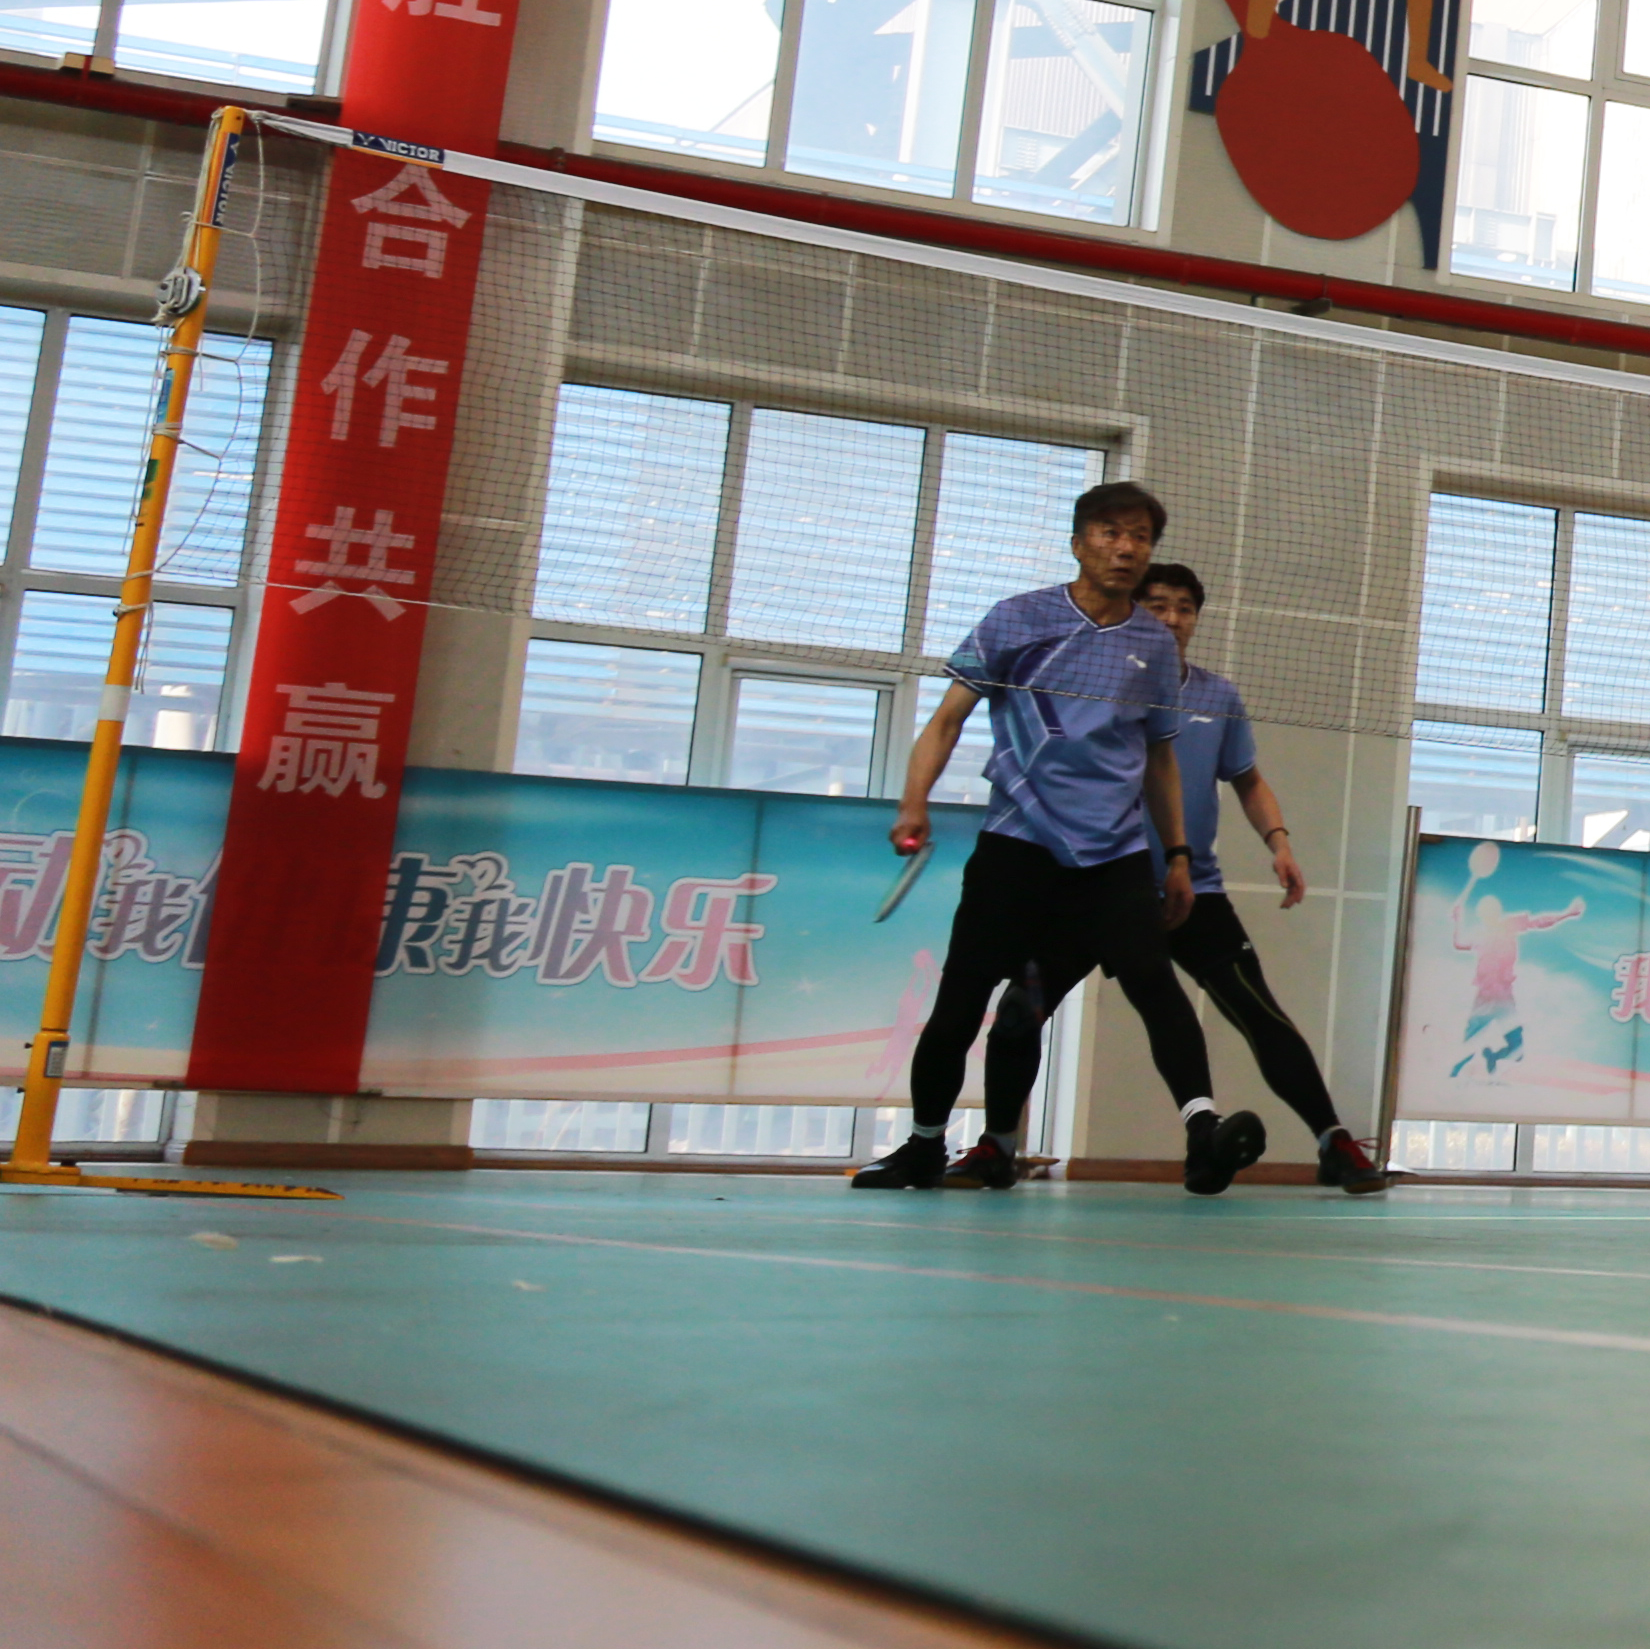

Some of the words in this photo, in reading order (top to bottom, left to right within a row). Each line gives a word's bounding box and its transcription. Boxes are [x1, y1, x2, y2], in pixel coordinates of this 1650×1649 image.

[378, 137, 440, 161] VICTOR
[256, 163, 473, 801] 合作共赢
